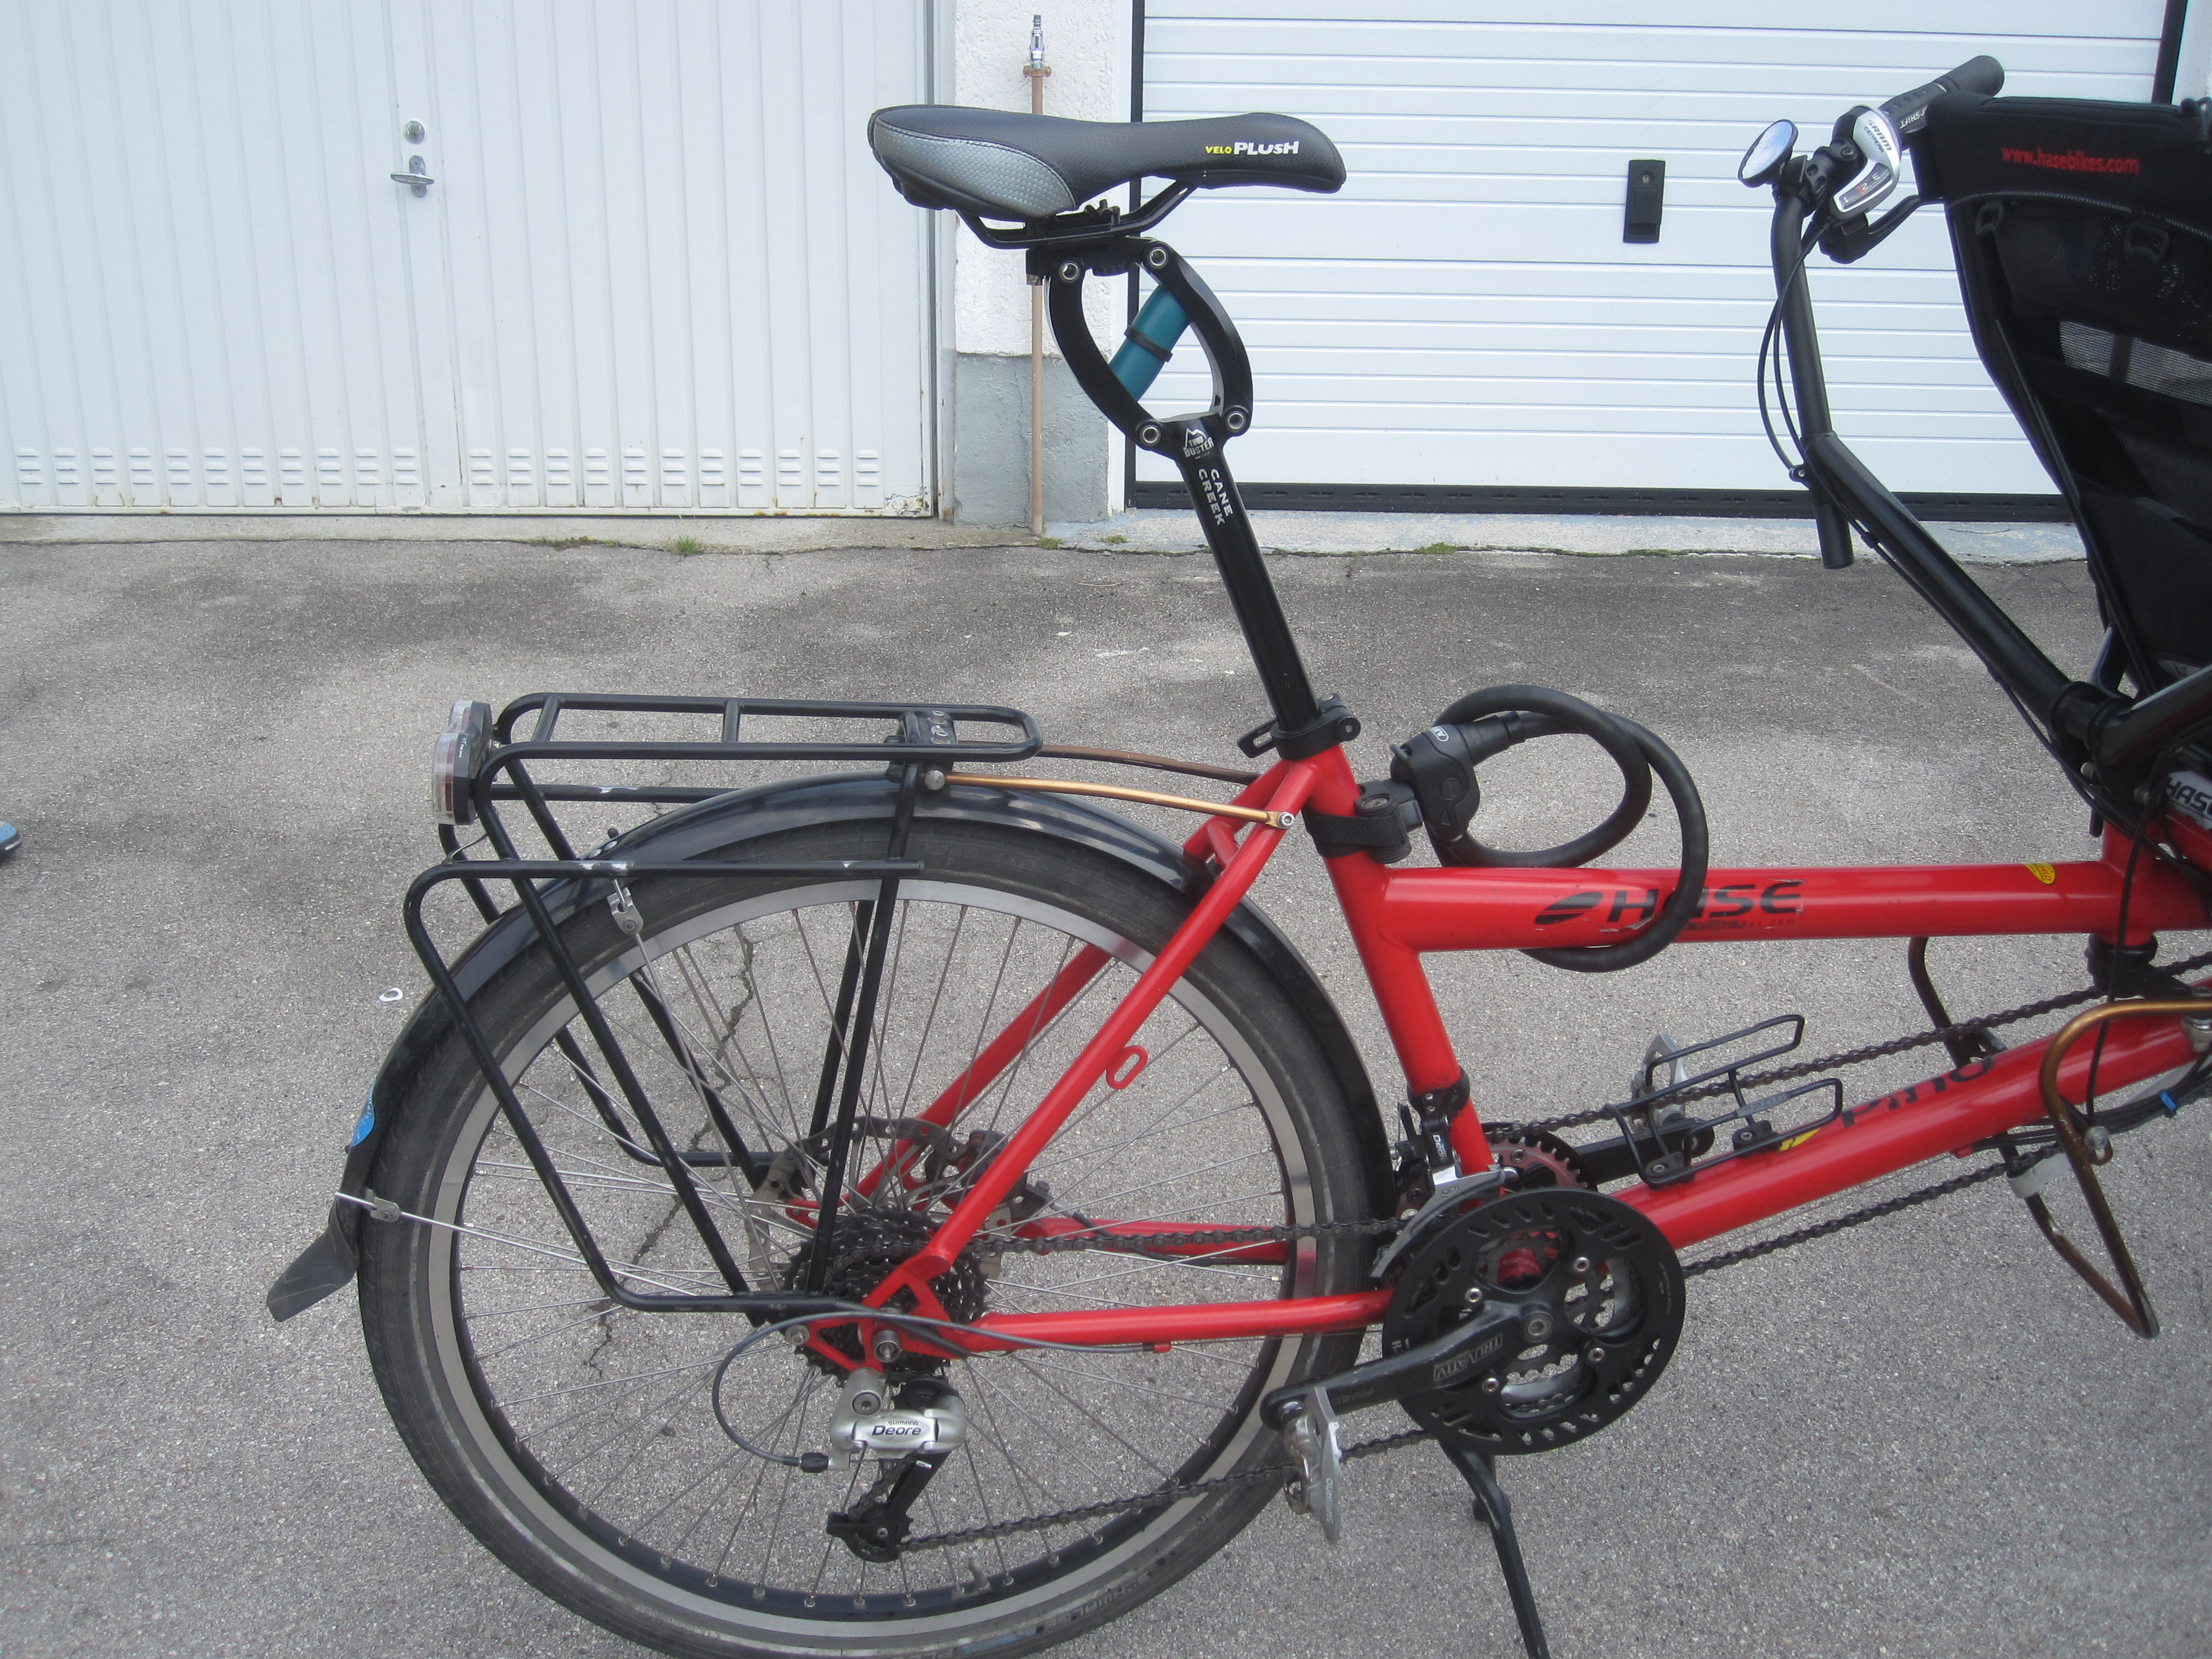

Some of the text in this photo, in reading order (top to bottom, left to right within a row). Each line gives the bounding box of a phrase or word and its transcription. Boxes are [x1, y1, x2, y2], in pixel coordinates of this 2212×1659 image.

[1205, 140, 1300, 155] VELO PLUSH
[1867, 119, 1892, 151] SRAM
[1182, 436, 1215, 458] BUSTER
[1198, 468, 1226, 526] CREEK
[1211, 468, 1234, 517] CANE
[2164, 776, 2212, 817] HAS
[1436, 1335, 1502, 1379] TRUVATIV
[871, 1425, 922, 1436] Deore
